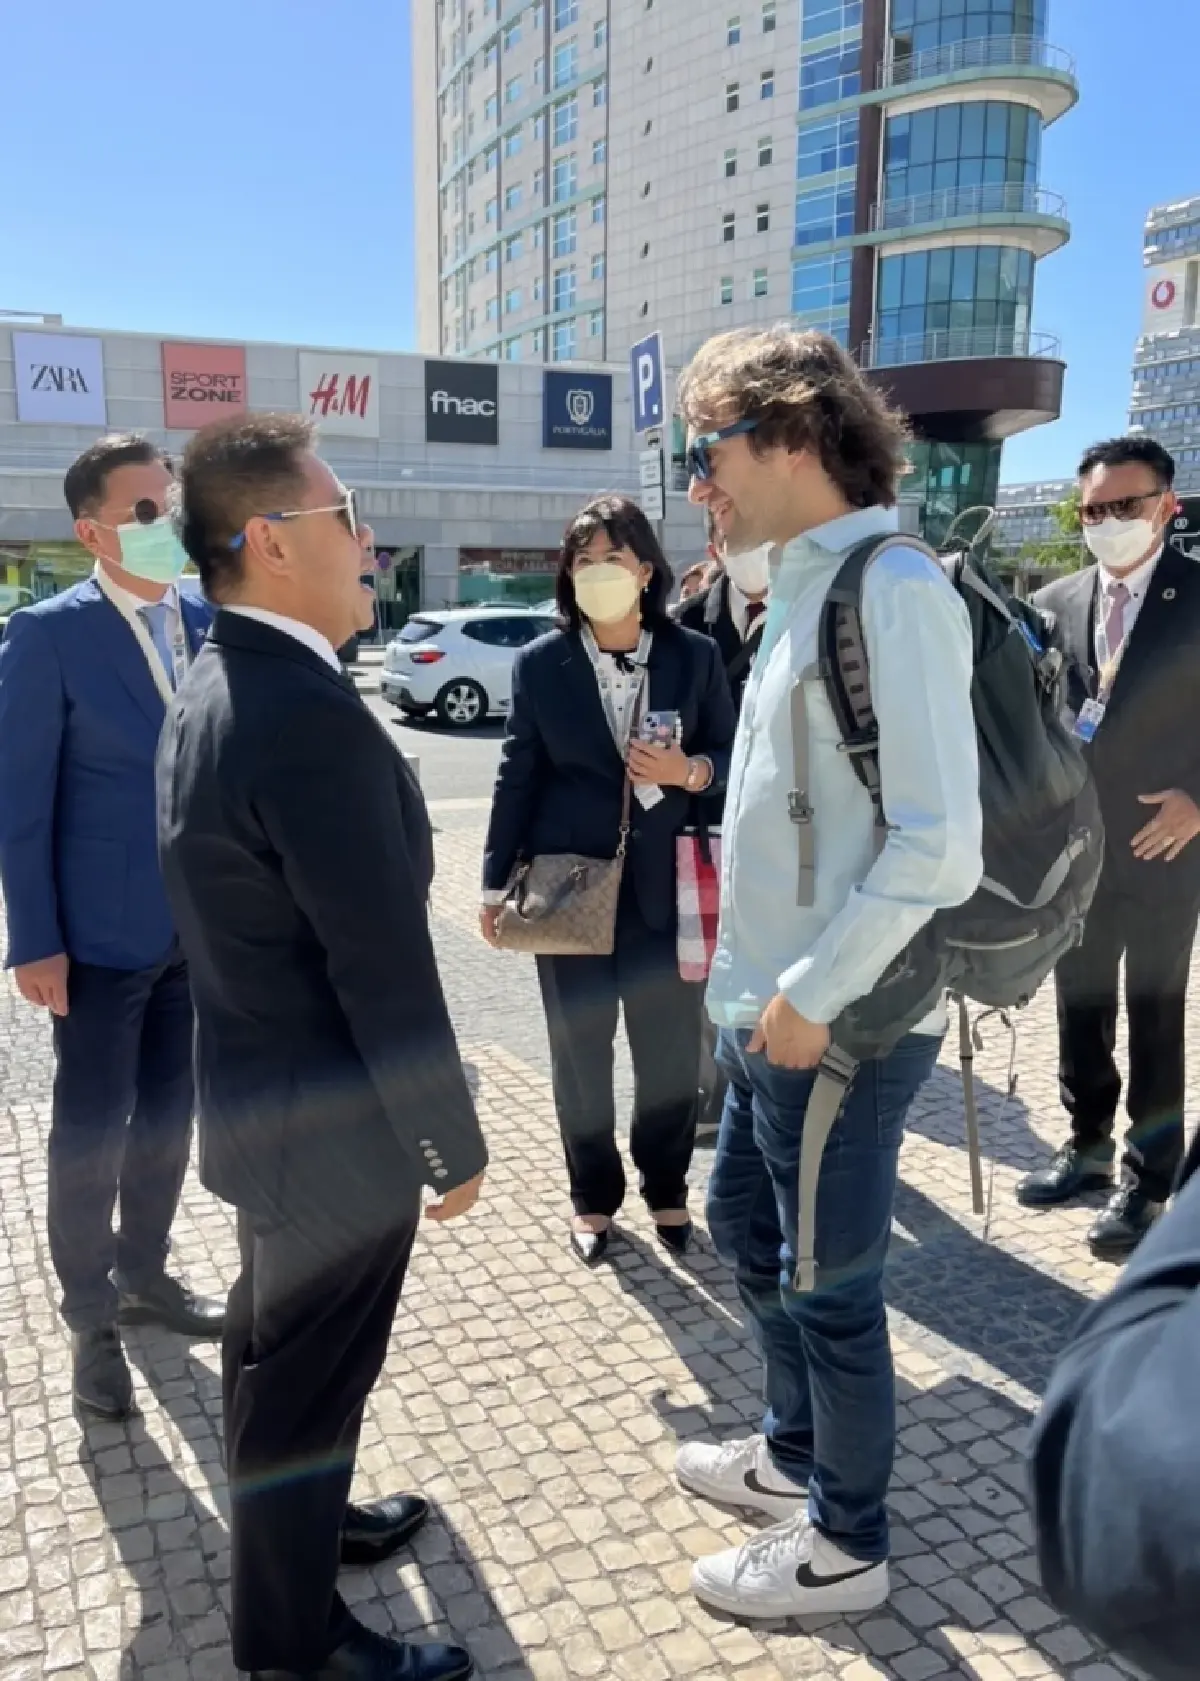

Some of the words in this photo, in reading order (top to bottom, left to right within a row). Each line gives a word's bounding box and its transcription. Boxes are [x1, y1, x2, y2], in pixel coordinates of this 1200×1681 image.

[30, 363, 89, 393] ZARA
[170, 371, 241, 388] SPORT
[170, 387, 241, 403] ZONE
[309, 372, 371, 419] H&M
[429, 389, 496, 416] fnac
